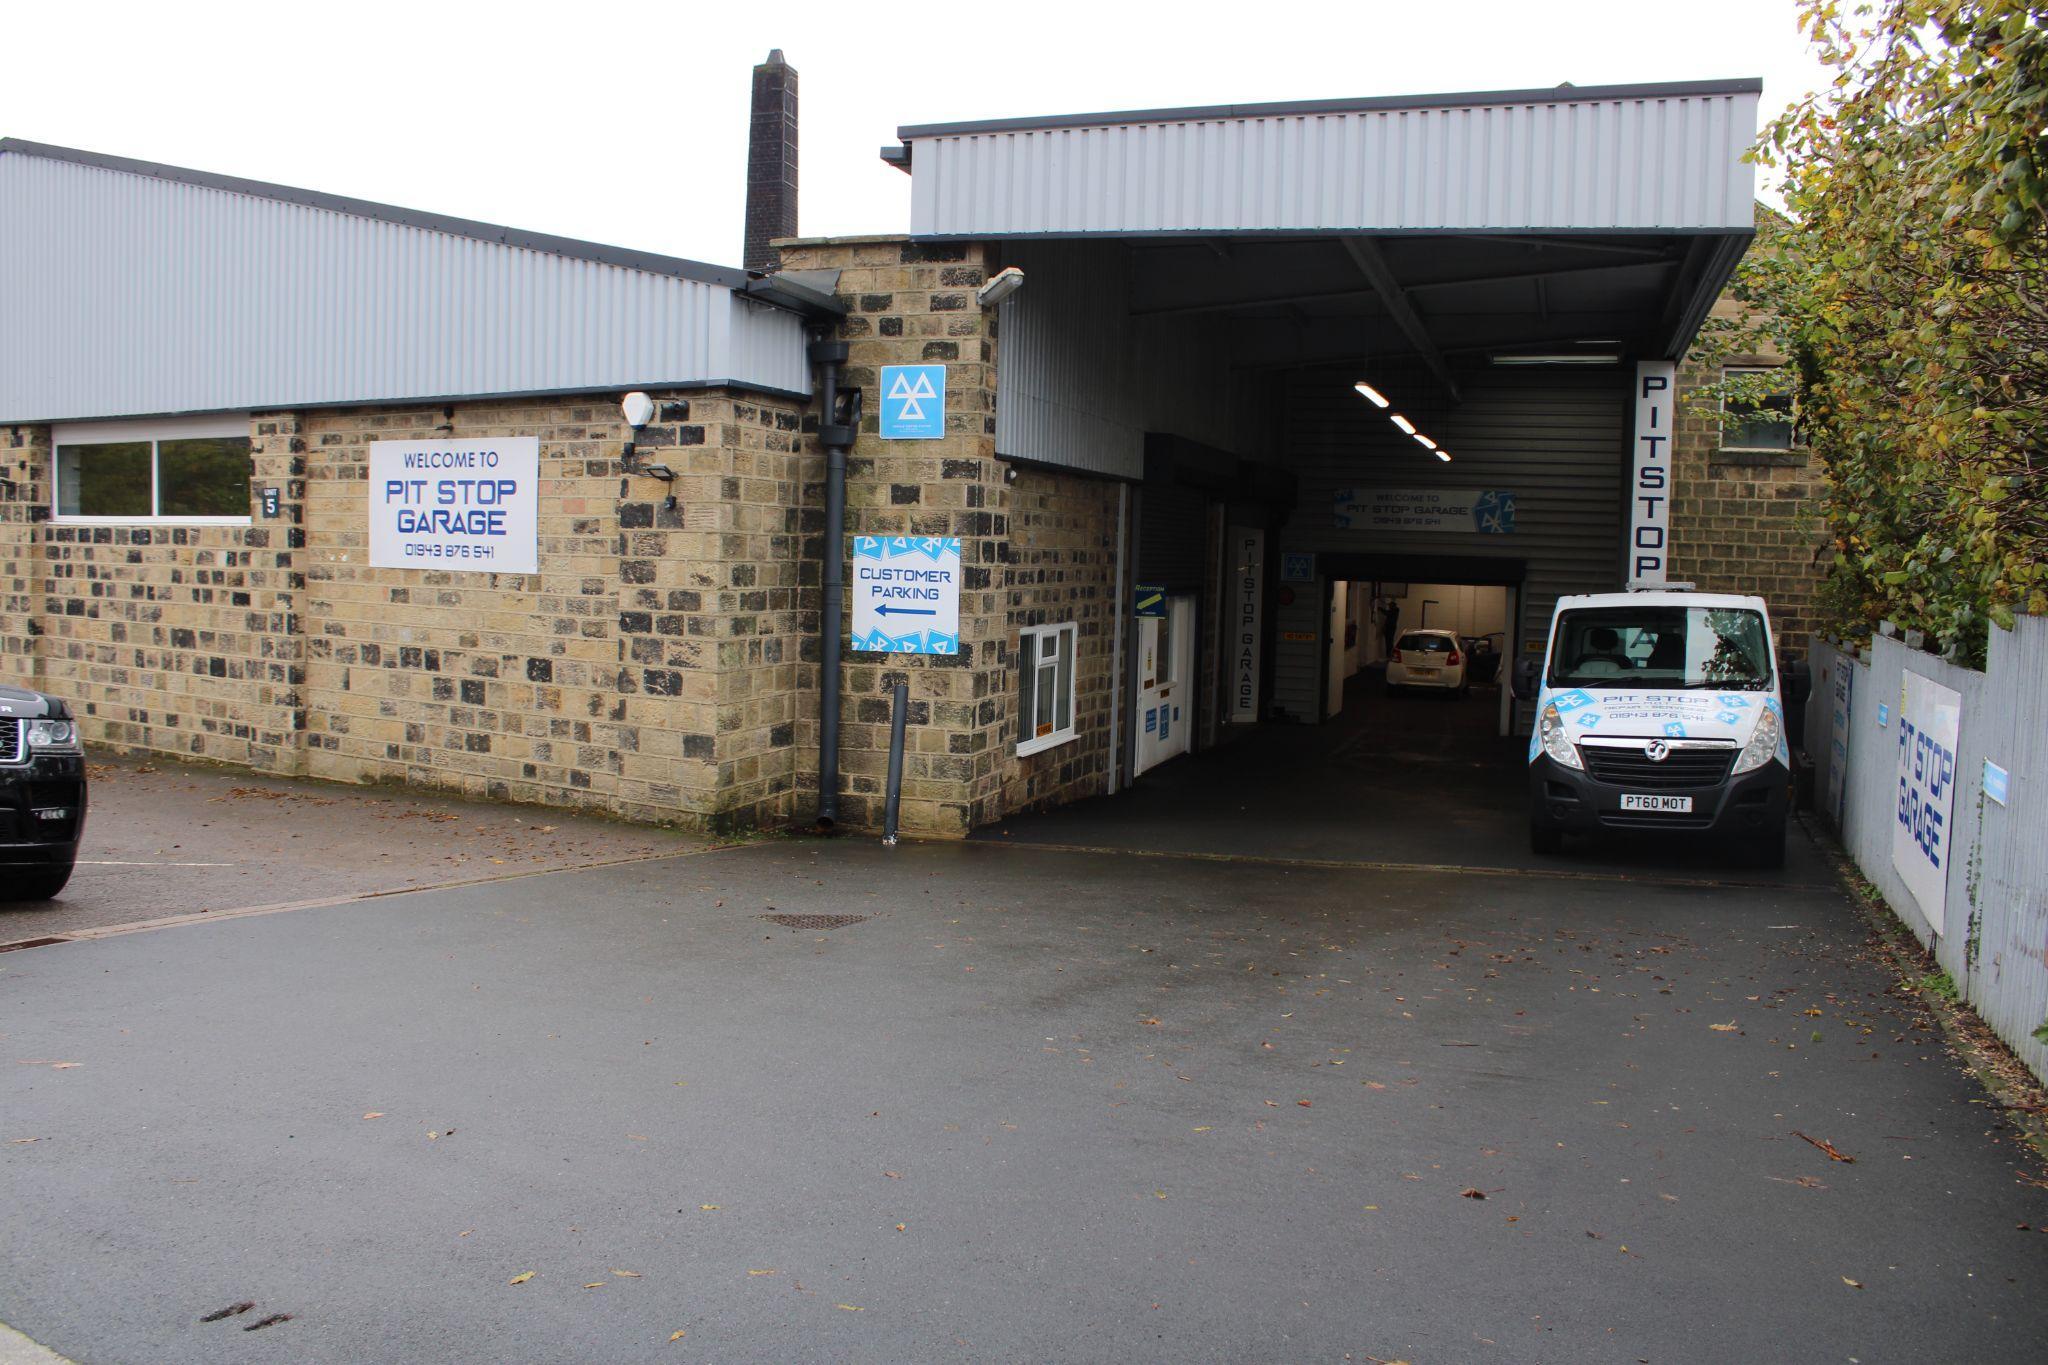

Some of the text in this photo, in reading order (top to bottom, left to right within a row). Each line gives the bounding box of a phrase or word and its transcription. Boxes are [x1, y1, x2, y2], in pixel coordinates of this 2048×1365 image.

[404, 451, 499, 468] WELCOME TO
[386, 480, 517, 505] PIT STOP
[1376, 494, 1440, 503] WELCOME TO
[267, 499, 275, 514] 5
[1346, 504, 1469, 516] PIT STOP GARAGE
[398, 509, 507, 535] GARAGE
[405, 543, 494, 559] 01943 876 541
[860, 567, 951, 584] CUSTOMER
[872, 585, 939, 601] PARKING
[1646, 695, 1709, 703] STOP
[1898, 716, 1915, 770] PIT
[1915, 730, 1953, 801] STOP
[1626, 796, 1687, 810] PT60 MOT
[1898, 775, 1943, 869] GARAGE
